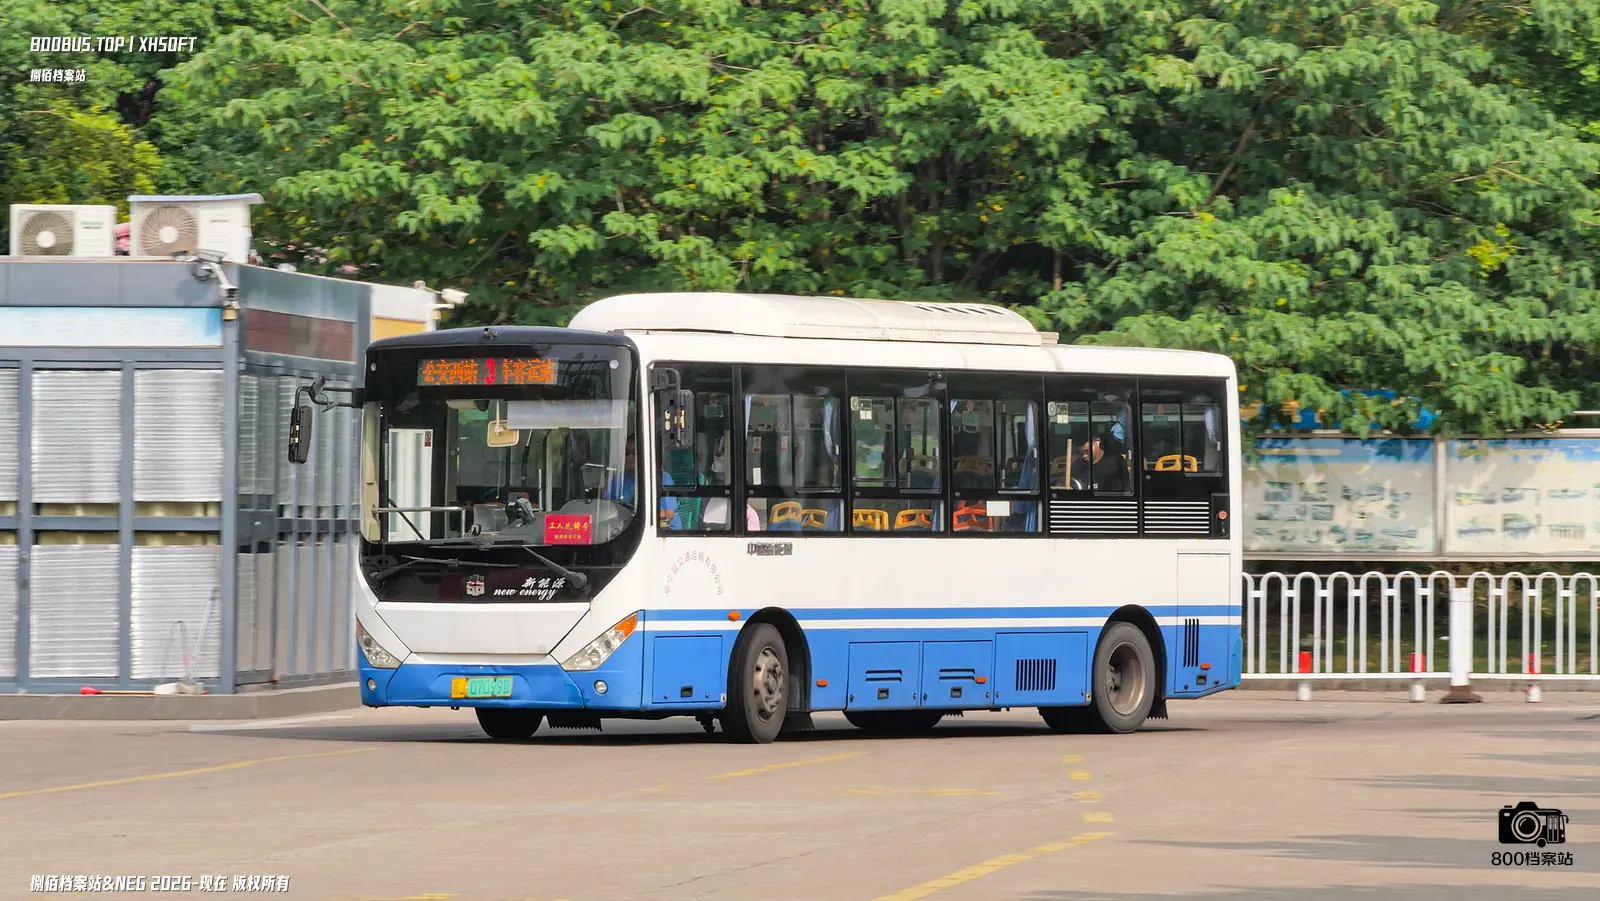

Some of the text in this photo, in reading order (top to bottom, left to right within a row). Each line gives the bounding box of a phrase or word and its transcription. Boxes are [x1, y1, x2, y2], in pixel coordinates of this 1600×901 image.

[485, 357, 496, 385] 3
[521, 576, 565, 588] 新能源
[493, 587, 558, 602] new energy
